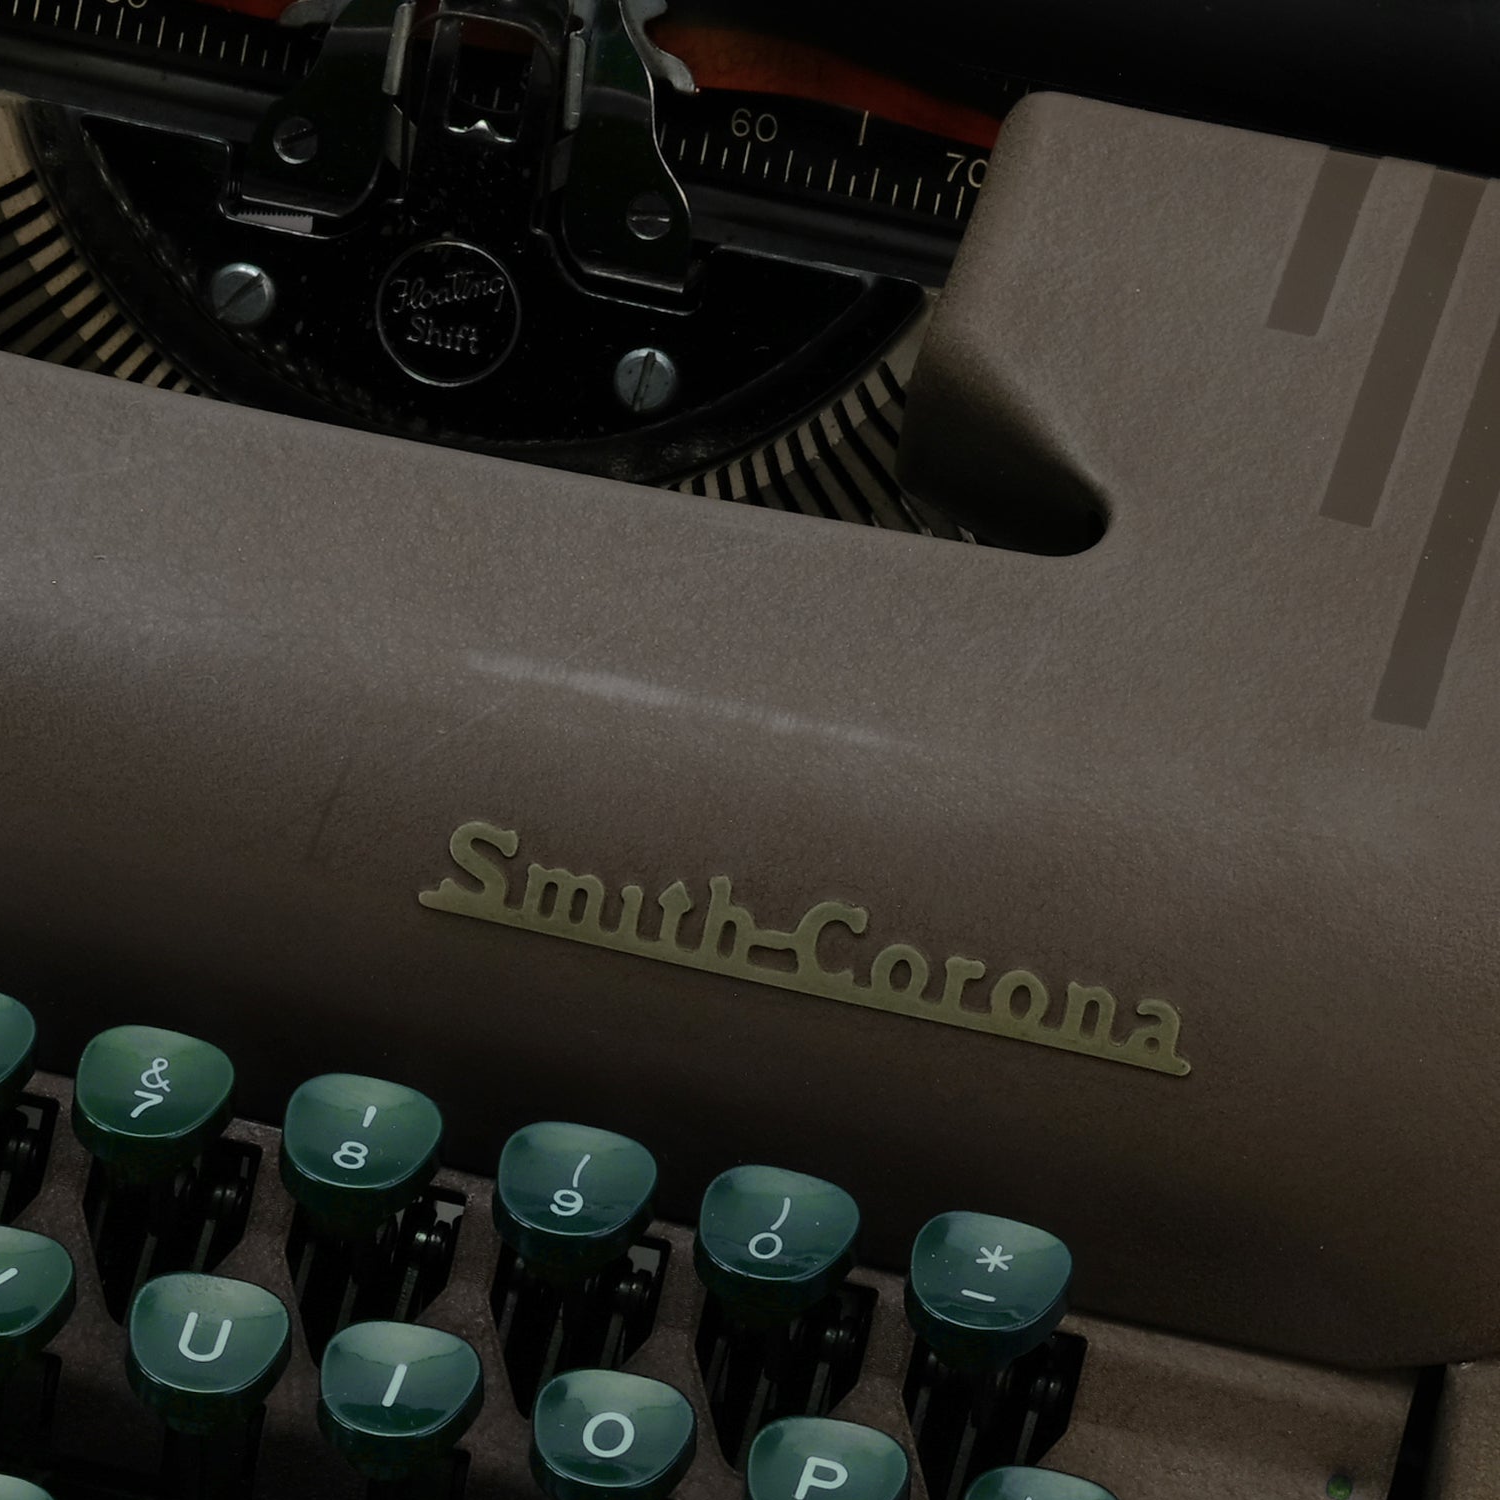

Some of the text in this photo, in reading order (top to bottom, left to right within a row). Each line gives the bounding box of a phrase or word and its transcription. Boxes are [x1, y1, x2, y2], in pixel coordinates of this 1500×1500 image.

[728, 104, 782, 145] 60
[944, 150, 988, 190] 70
[390, 270, 505, 313] Floating
[406, 314, 481, 356] Shift
[418, 820, 1192, 1077] Smith-Corona
[140, 1057, 171, 1092] &
[130, 1089, 164, 1118] 7
[332, 1141, 369, 1170] 8
[572, 1153, 591, 1188] (
[549, 1189, 584, 1216] 9
[770, 1196, 791, 1231] )
[178, 1311, 233, 1362] U
[381, 1359, 408, 1407] I
[582, 1411, 635, 1458] O
[794, 1455, 848, 1500] P
